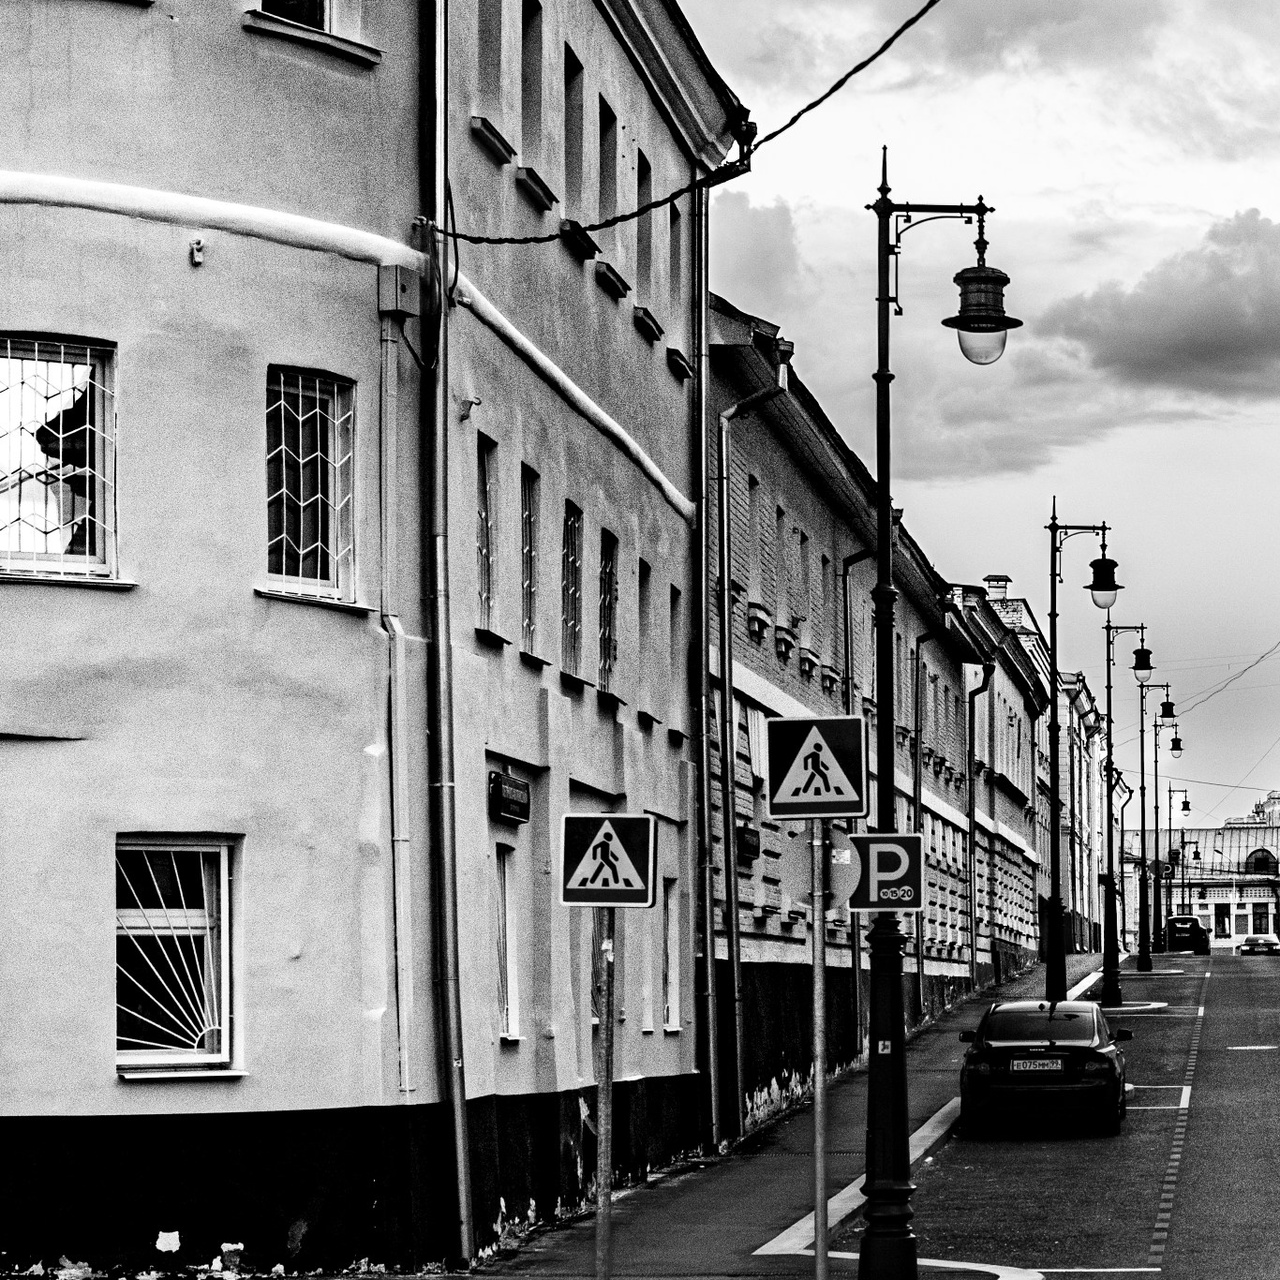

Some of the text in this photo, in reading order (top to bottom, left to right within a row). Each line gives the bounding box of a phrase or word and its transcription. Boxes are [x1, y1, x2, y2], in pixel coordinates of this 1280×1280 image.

[869, 843, 910, 902] P
[881, 888, 913, 899] 10 15 20
